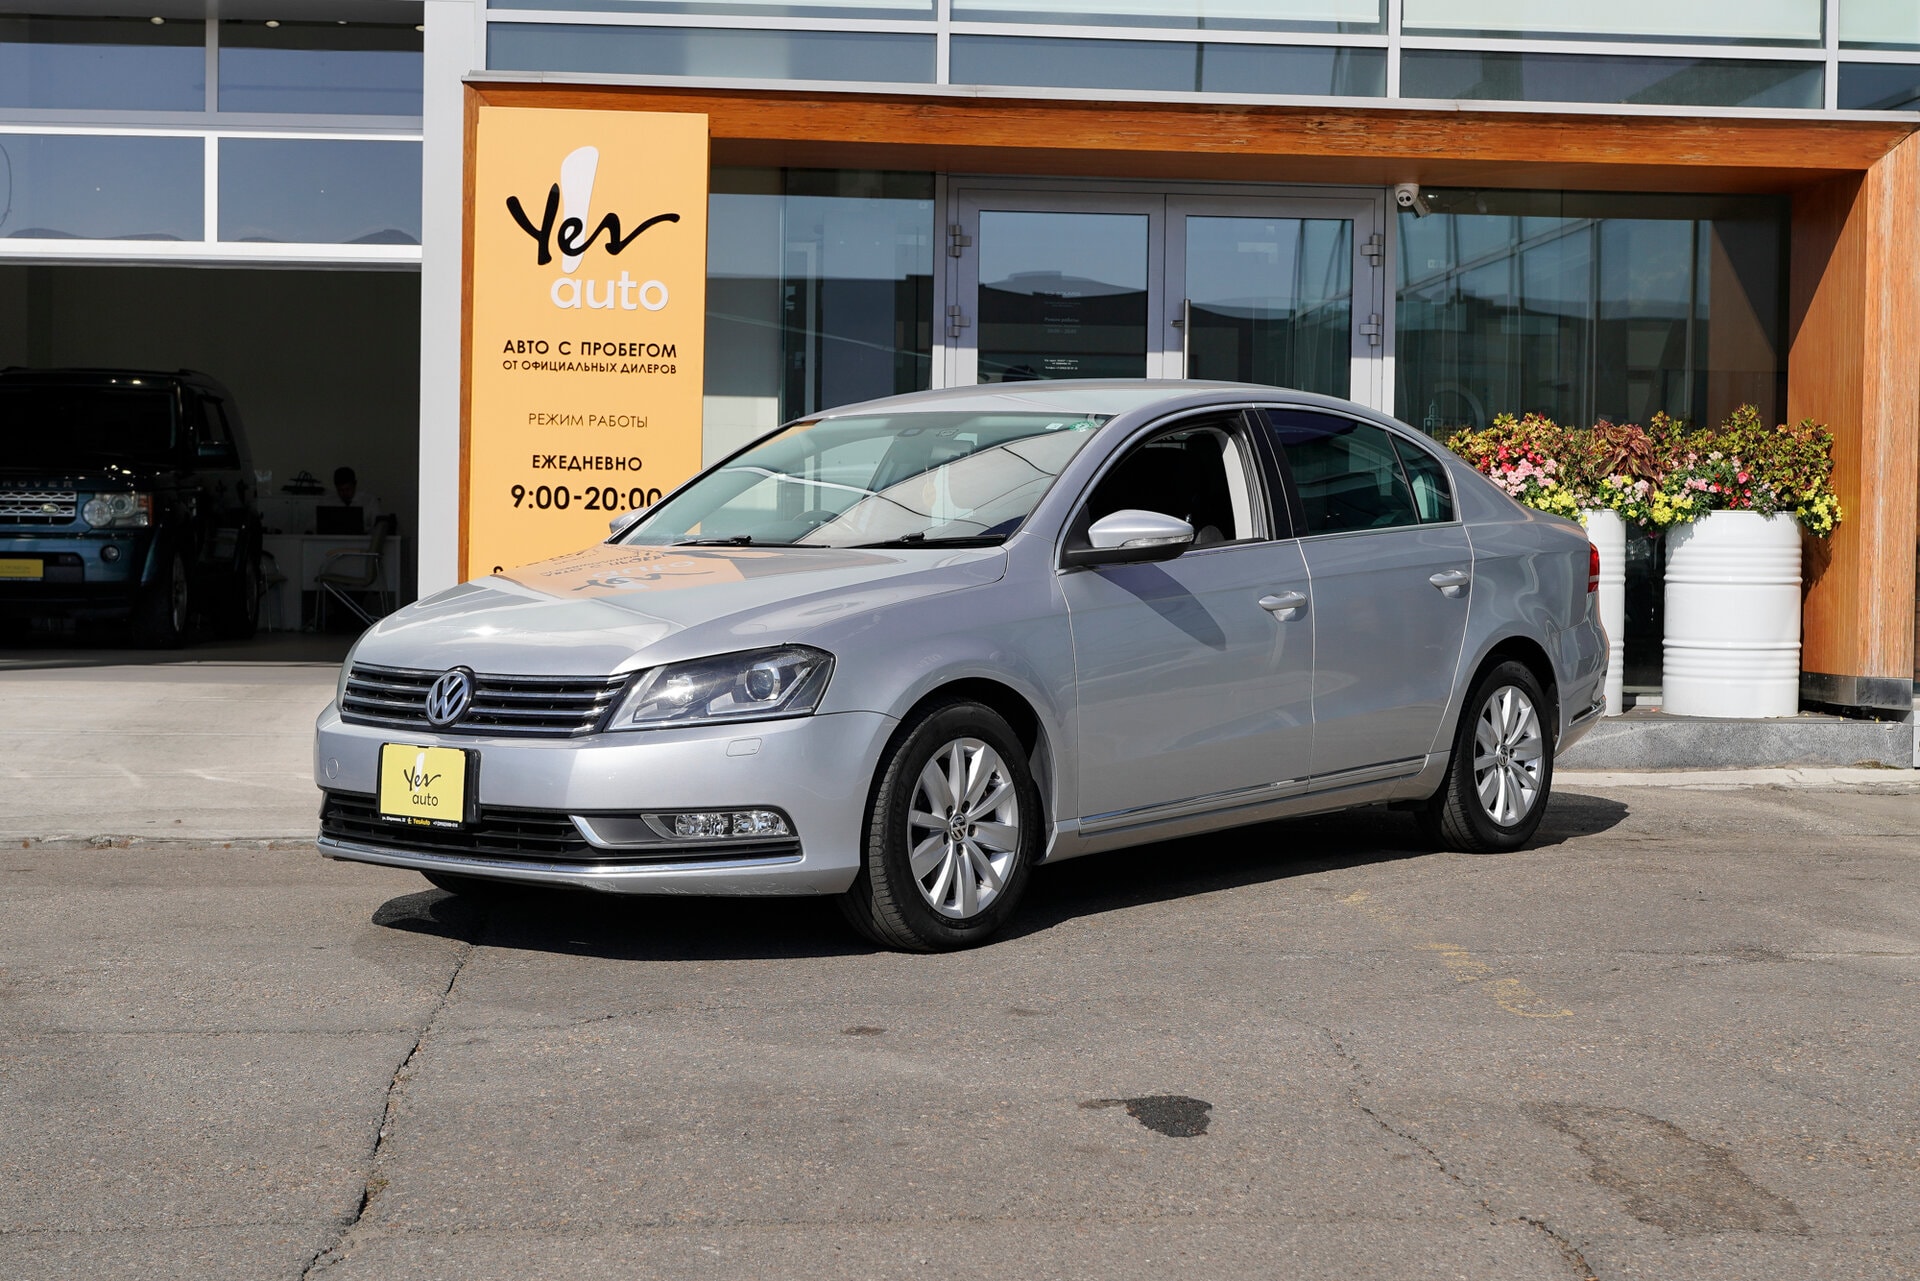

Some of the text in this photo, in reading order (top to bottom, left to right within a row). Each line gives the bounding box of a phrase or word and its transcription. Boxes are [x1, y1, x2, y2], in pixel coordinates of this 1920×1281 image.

[550, 270, 669, 311] auto
[503, 339, 677, 358] АВТО С ПРОБЕГОМ
[502, 360, 677, 374] ОТ ОФИЦИАЛЬНЫХ ДИЛЕРОВ
[528, 412, 648, 429] РЕЖИМ РАБОТЫ
[532, 454, 642, 472] ЕЖЕДНЕВНО
[412, 792, 439, 807] auto
